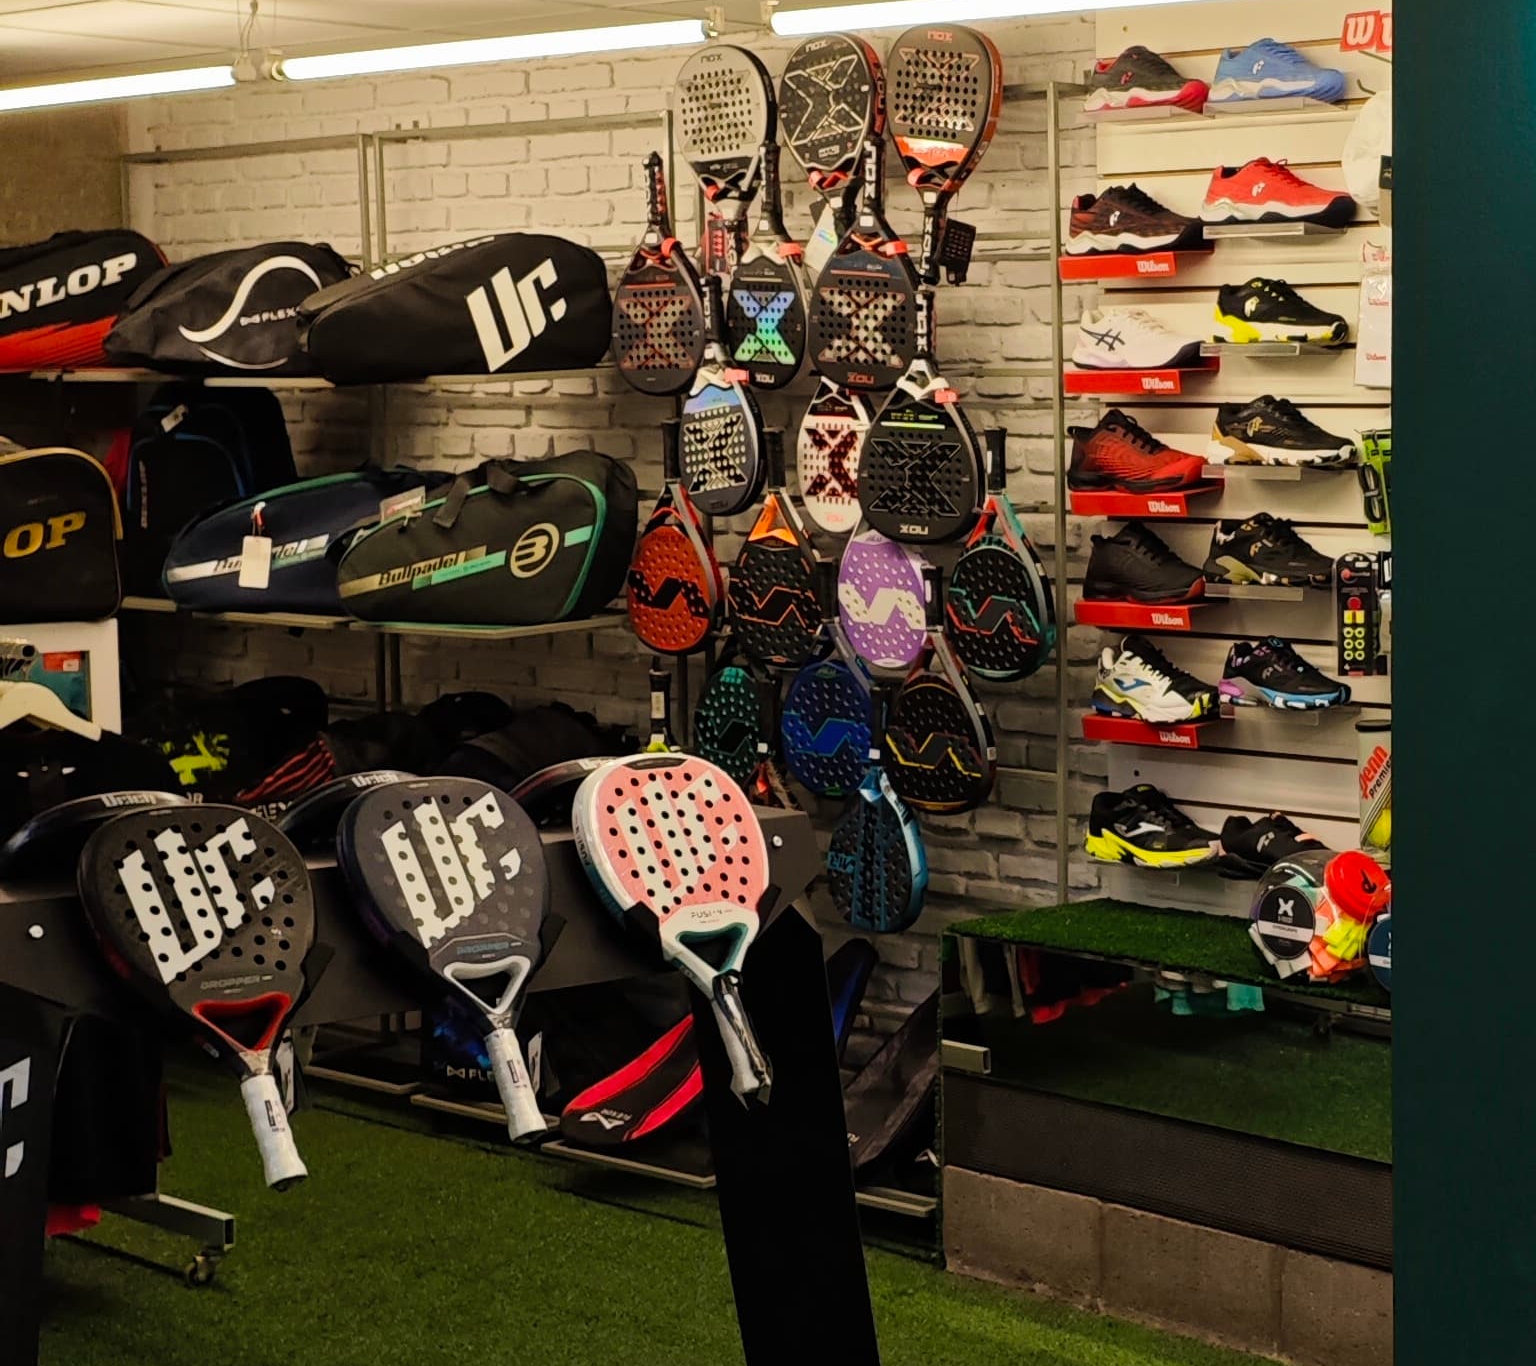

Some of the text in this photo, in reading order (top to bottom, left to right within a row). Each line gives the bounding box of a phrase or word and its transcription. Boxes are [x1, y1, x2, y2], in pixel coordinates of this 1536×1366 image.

[1147, 500, 1181, 514] Wilson
[378, 552, 465, 586] Bullpadel
[1151, 613, 1184, 627] Wilson
[1159, 731, 1191, 745] Wilson
